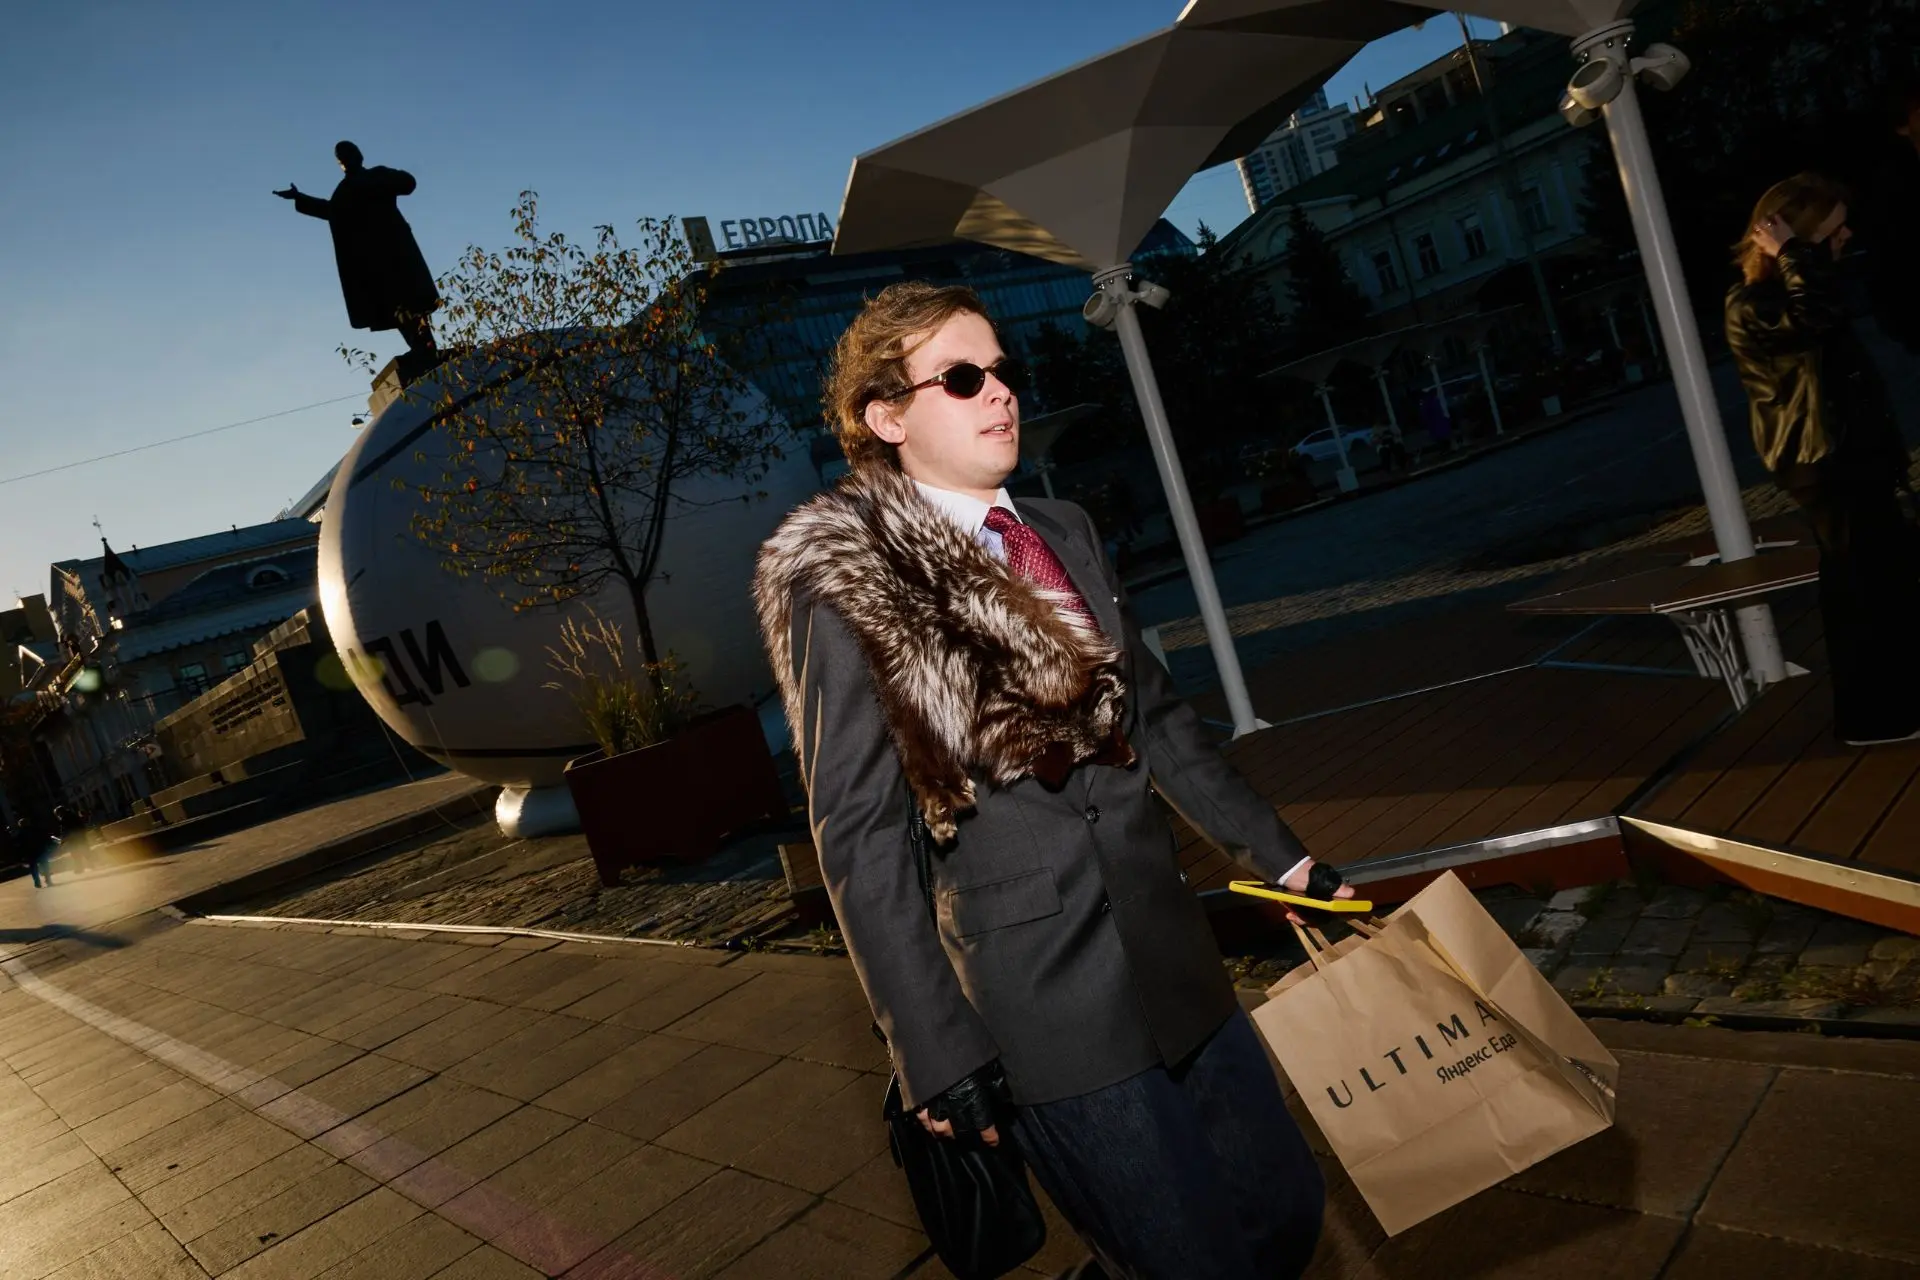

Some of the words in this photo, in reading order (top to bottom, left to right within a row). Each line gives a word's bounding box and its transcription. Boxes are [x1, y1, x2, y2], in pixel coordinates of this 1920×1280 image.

[720, 211, 834, 249] ЕВРОПА
[348, 619, 471, 706] ДИ
[1325, 999, 1498, 1108] ULTIMA
[1436, 1048, 1493, 1085] Яндекс
[1488, 1031, 1518, 1055] Еда
